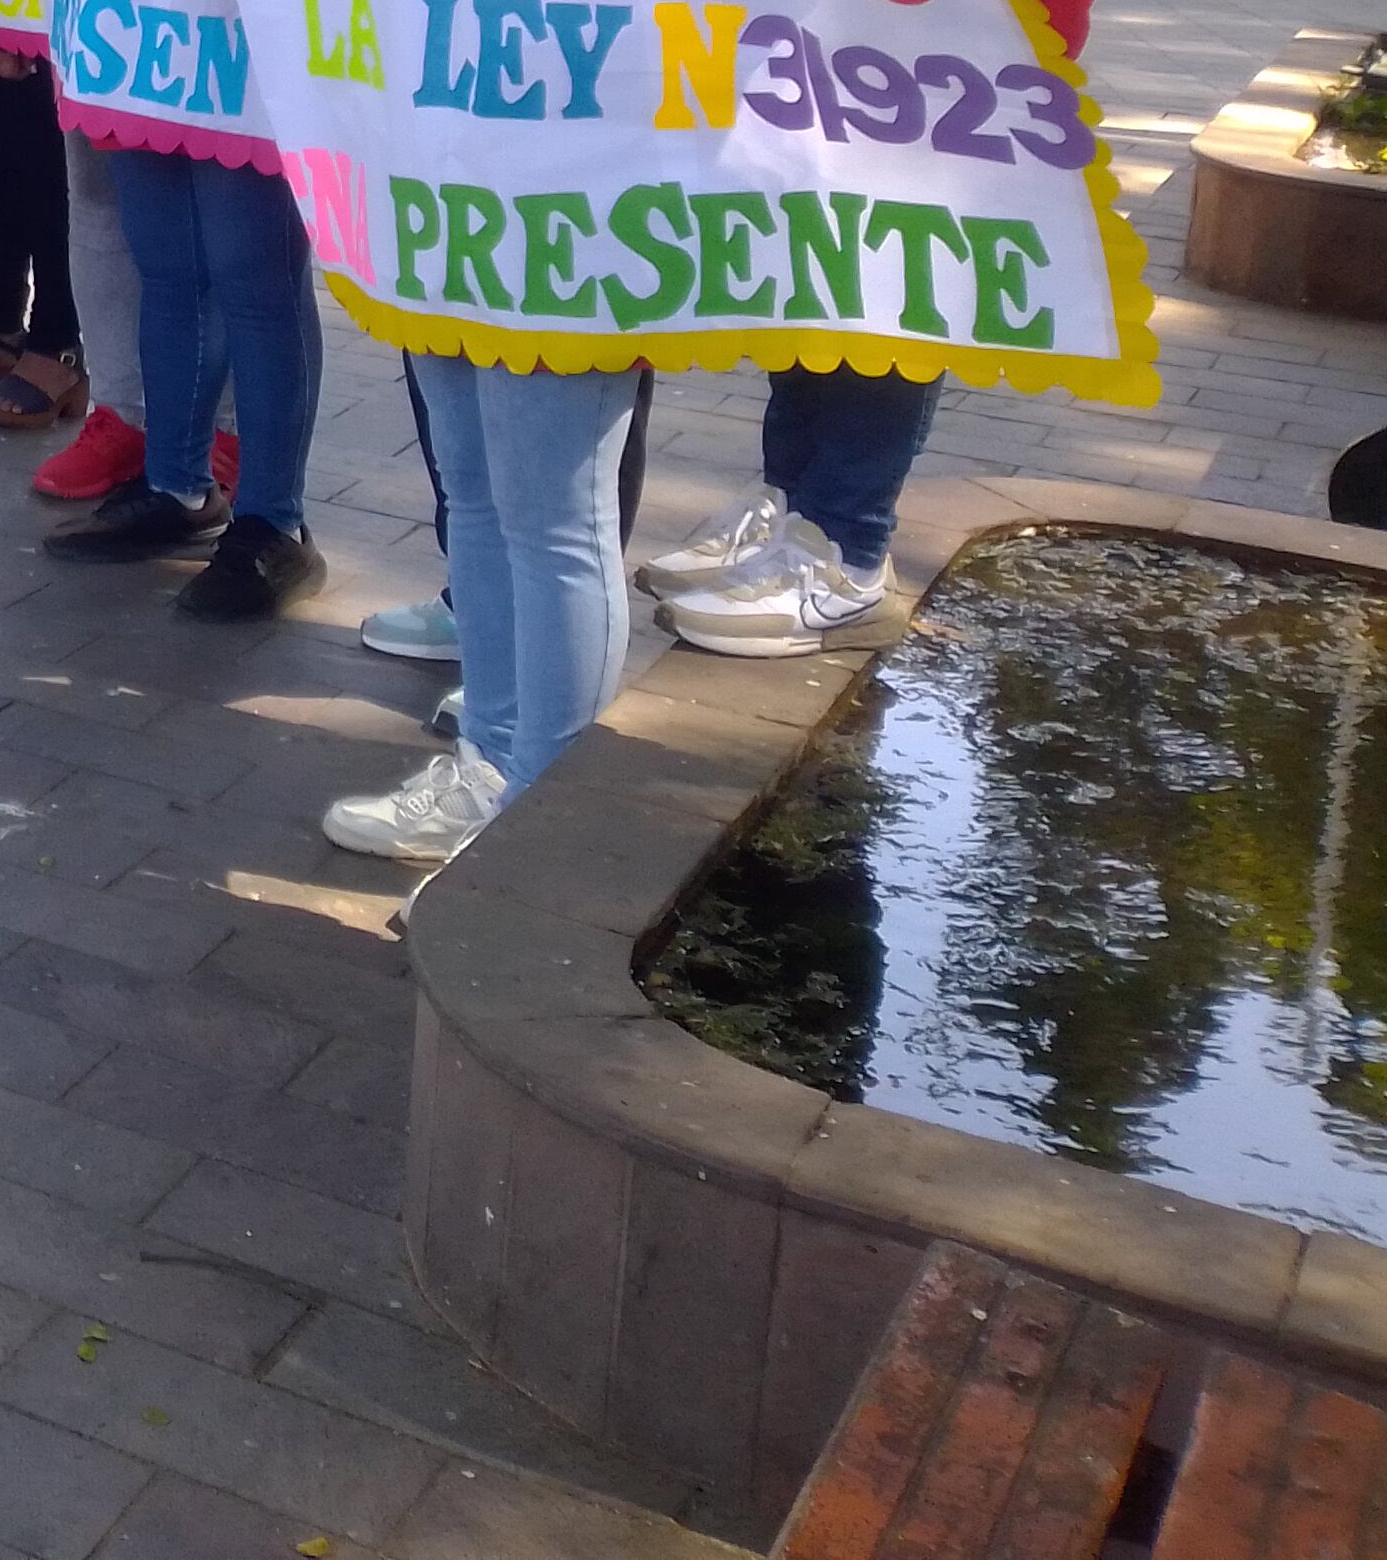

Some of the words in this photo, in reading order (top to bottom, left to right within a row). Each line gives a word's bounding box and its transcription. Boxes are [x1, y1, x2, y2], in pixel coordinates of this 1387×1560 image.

[653, 1, 748, 130] N
[738, 13, 1098, 169] 31923
[389, 174, 1056, 349] PRESENTE
